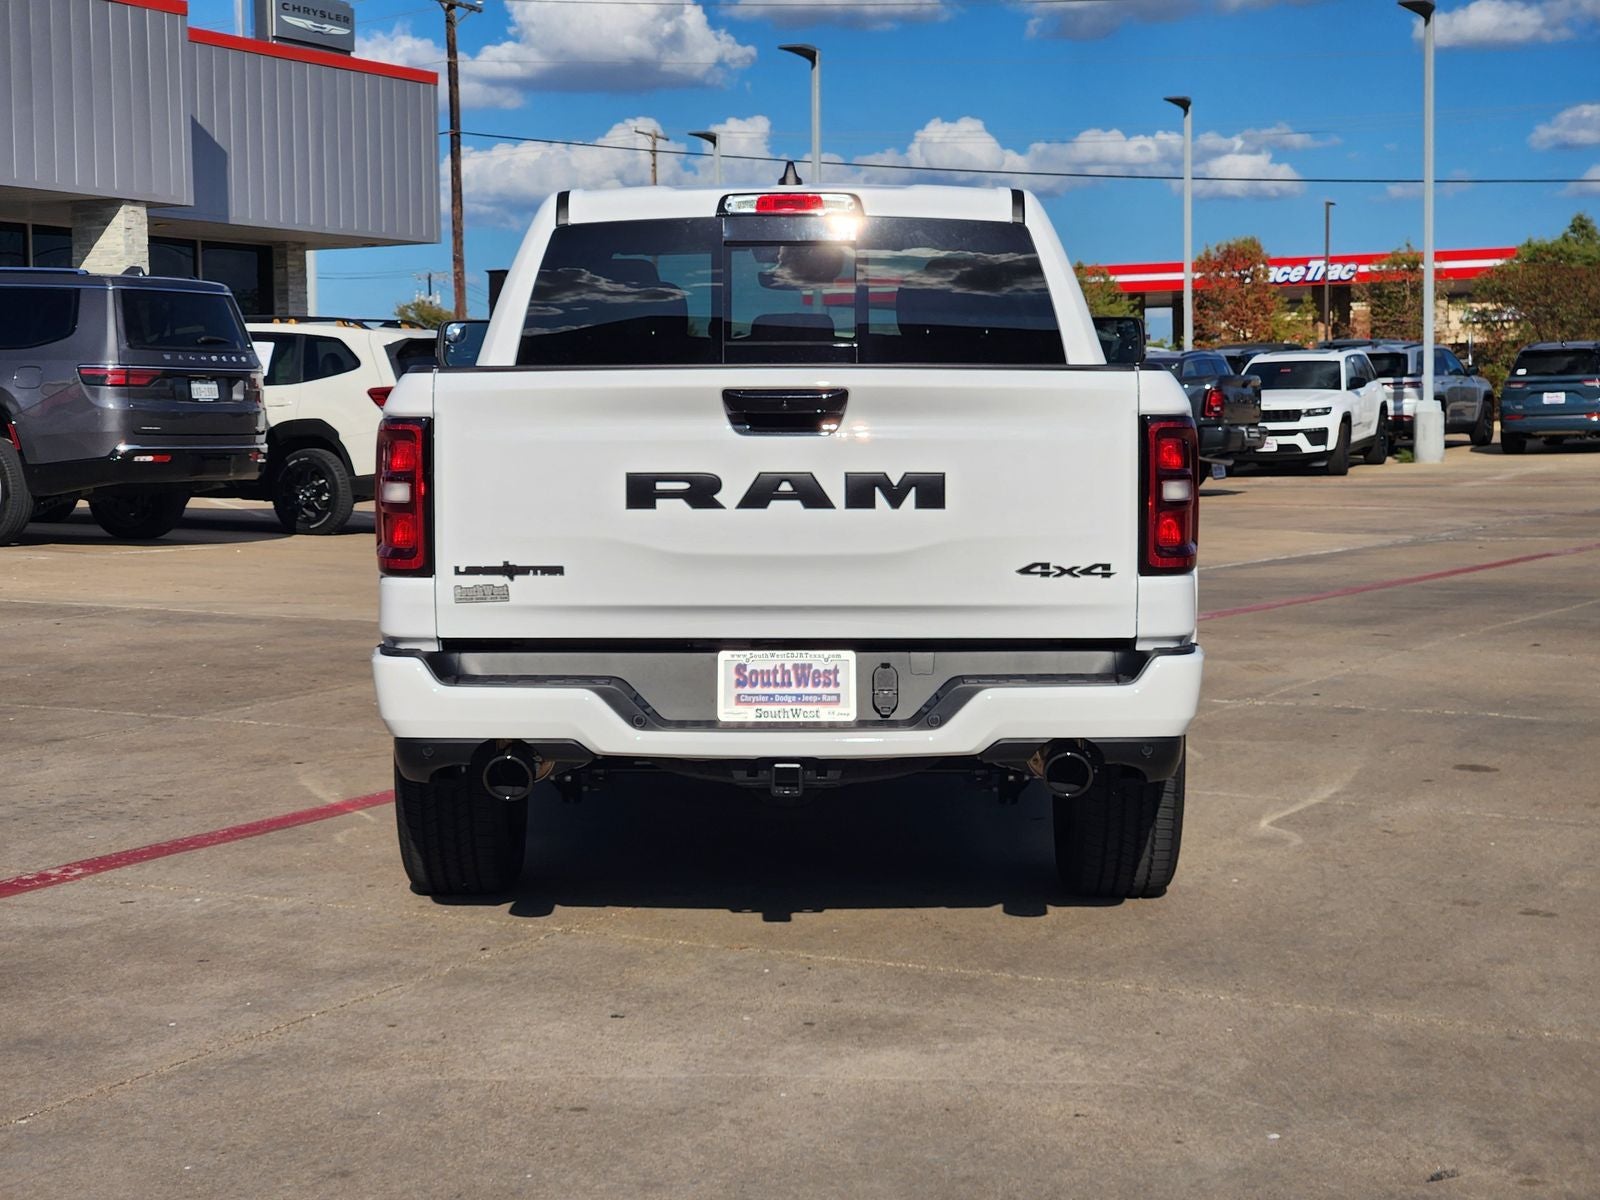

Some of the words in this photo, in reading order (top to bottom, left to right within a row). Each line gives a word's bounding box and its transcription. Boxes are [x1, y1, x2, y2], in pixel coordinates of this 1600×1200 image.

[281, 2, 350, 25] CHRYSLER
[1244, 259, 1357, 284] aceTrac
[625, 471, 946, 510] RAM
[1015, 562, 1117, 578] 4x4
[735, 662, 840, 688] SouthWest
[740, 694, 769, 703] Chrysler
[774, 694, 797, 703] Dodge
[801, 694, 818, 703] Jeep
[821, 694, 838, 702] Ram
[755, 708, 821, 719] SouthWest
